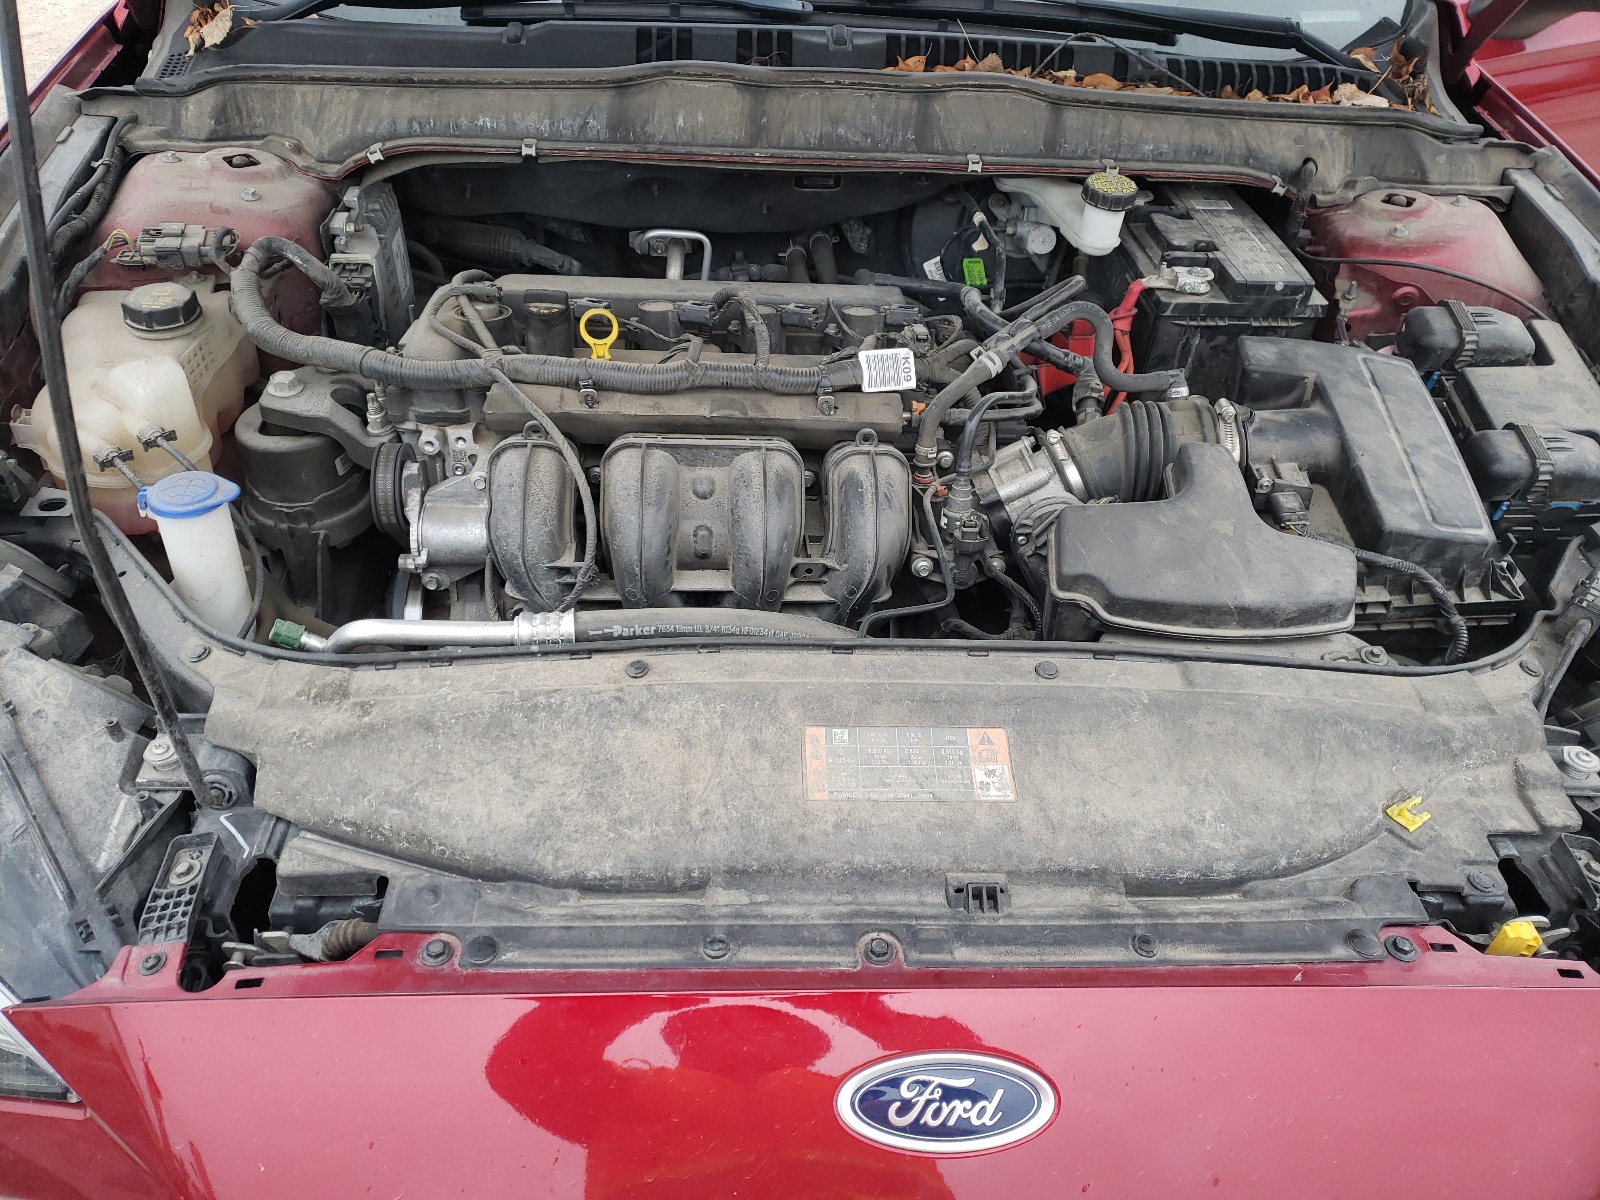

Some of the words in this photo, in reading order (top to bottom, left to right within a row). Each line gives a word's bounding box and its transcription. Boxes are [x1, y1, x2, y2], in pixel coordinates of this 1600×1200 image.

[902, 356, 912, 382] K09
[603, 624, 657, 637] Parker
[658, 625, 674, 633] 7634
[676, 625, 693, 633] 19mm
[888, 1075, 1005, 1127] Ford
